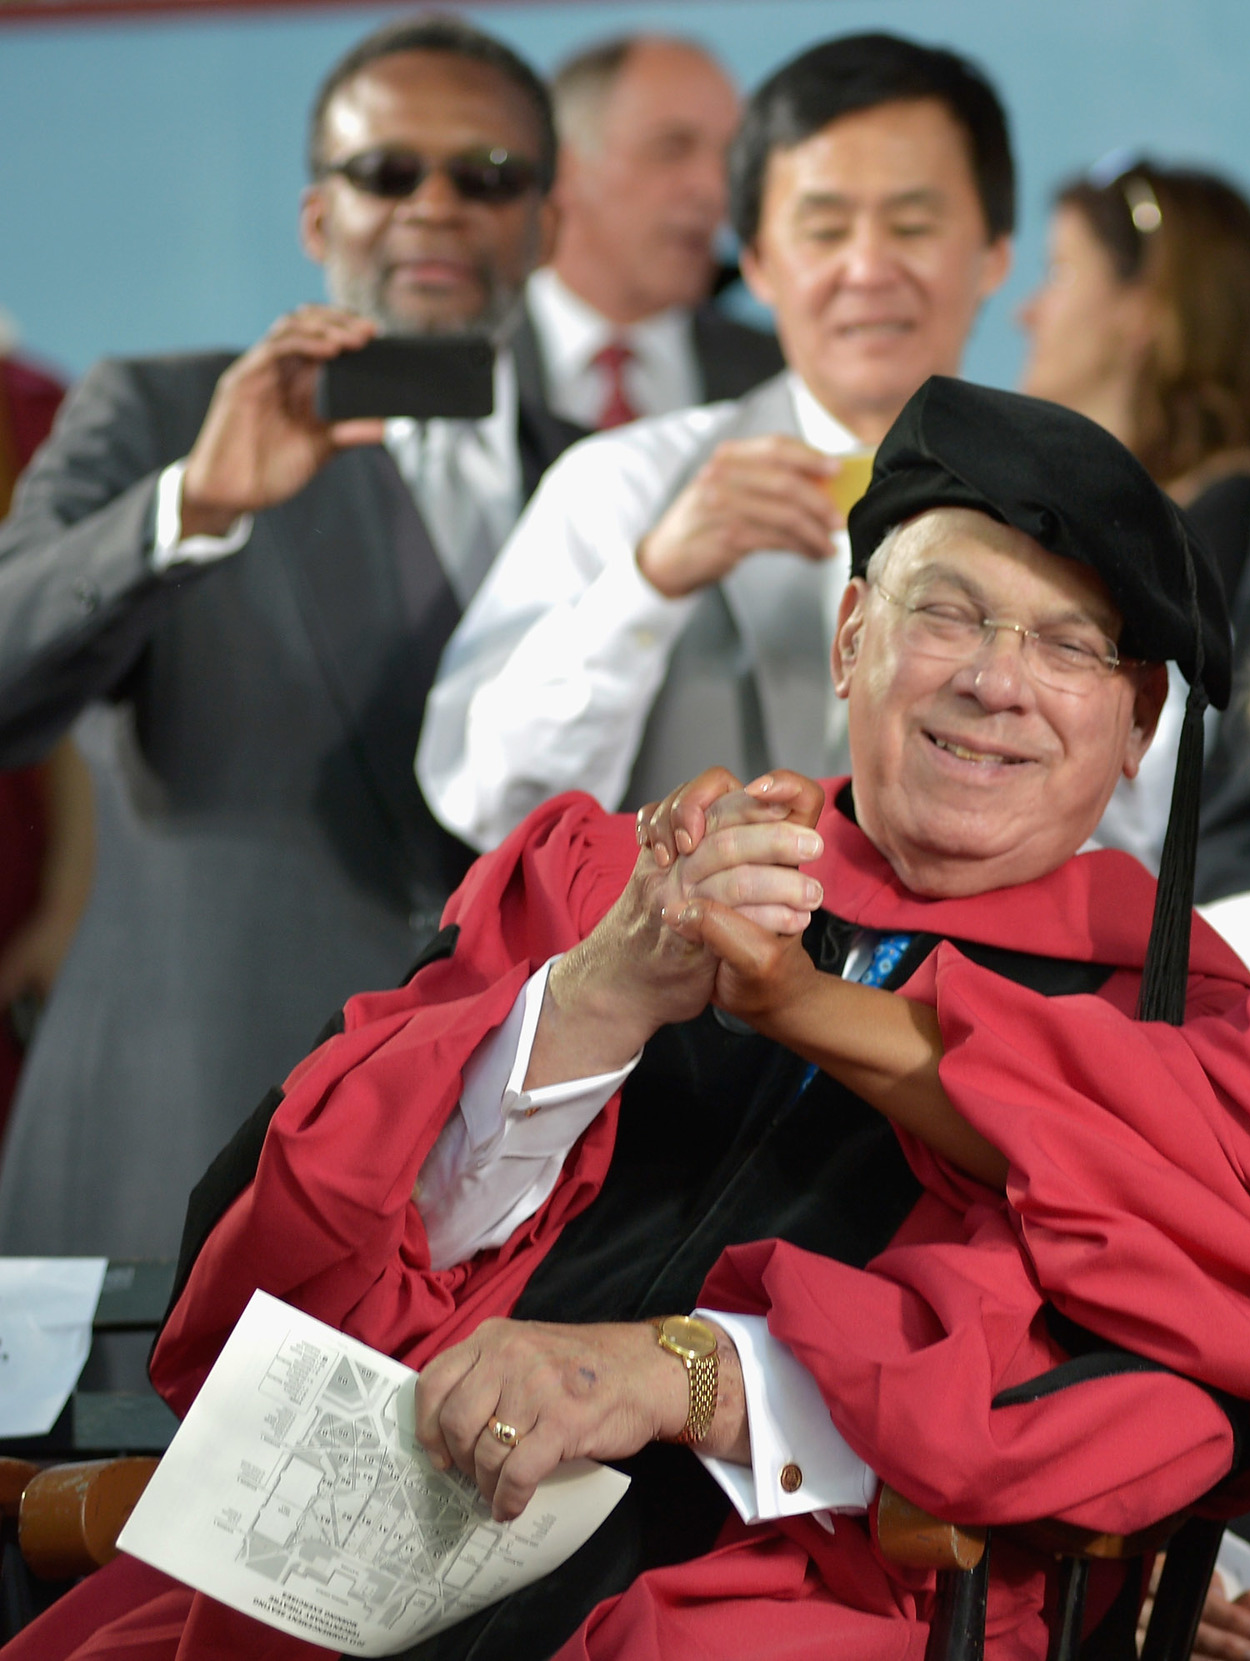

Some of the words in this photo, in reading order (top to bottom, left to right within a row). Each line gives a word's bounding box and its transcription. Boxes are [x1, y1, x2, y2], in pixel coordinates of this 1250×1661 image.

[252, 1598, 286, 1618] SEATING
[269, 1596, 303, 1616] THEATRE
[282, 1591, 324, 1614] EXERCISES
[288, 1614, 349, 1643] COMMENCEMENT
